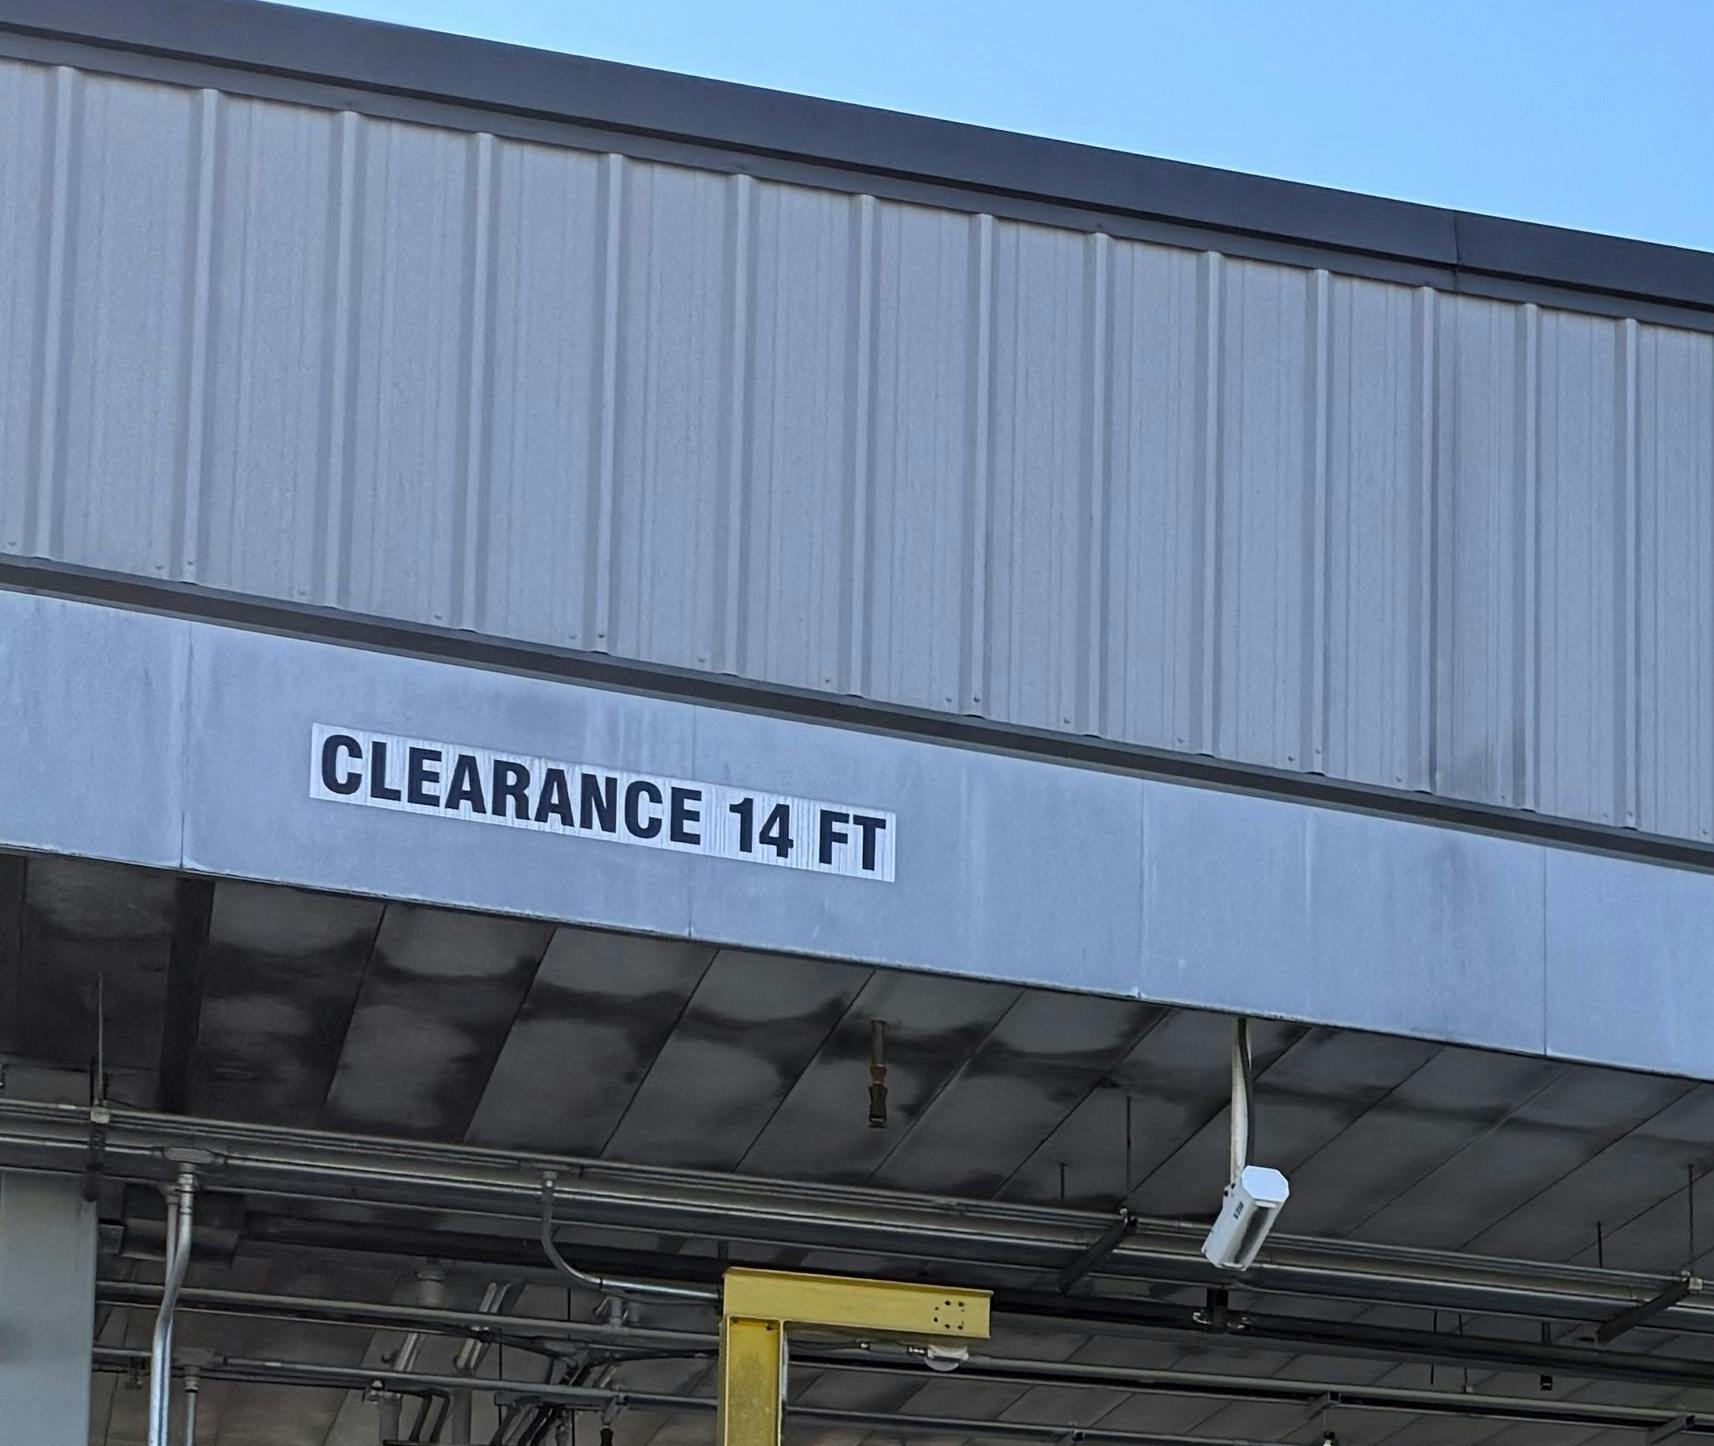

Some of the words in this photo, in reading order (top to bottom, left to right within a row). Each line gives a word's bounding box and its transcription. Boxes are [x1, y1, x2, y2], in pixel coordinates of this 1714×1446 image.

[321, 734, 702, 845] CLEARANCE
[729, 798, 794, 858] 14
[818, 809, 887, 871] FT
